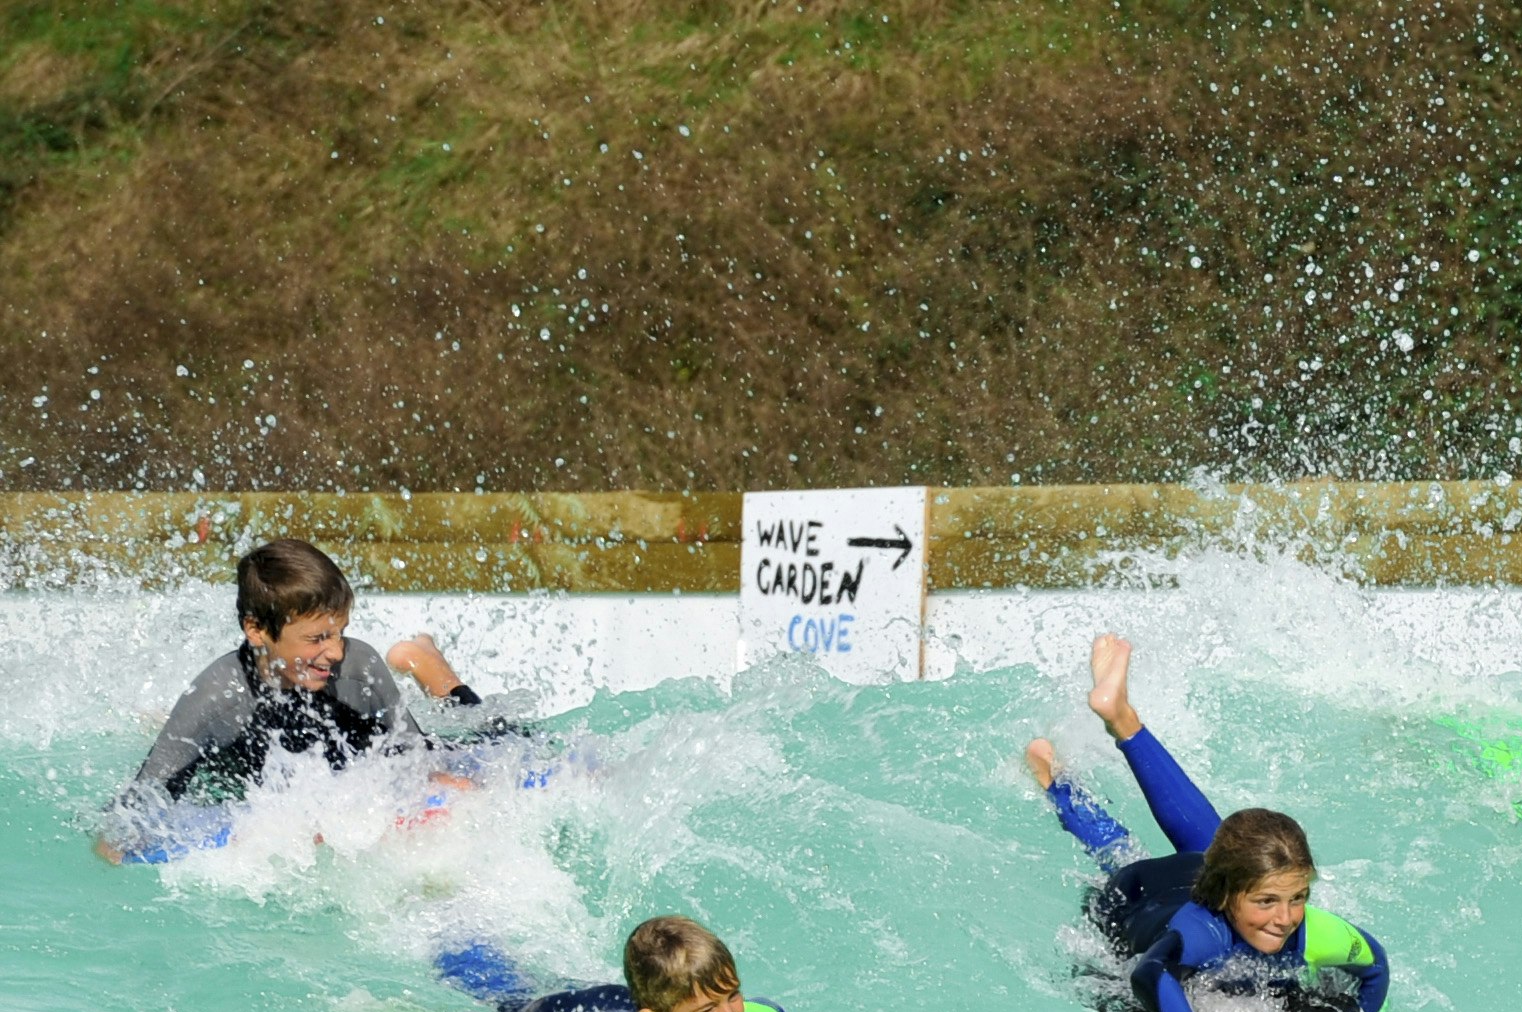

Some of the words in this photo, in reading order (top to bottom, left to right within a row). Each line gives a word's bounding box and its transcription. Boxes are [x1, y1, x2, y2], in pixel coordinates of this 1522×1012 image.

[757, 519, 824, 556] WAVE
[757, 558, 864, 605] GARDEN
[788, 613, 854, 653] COVE
